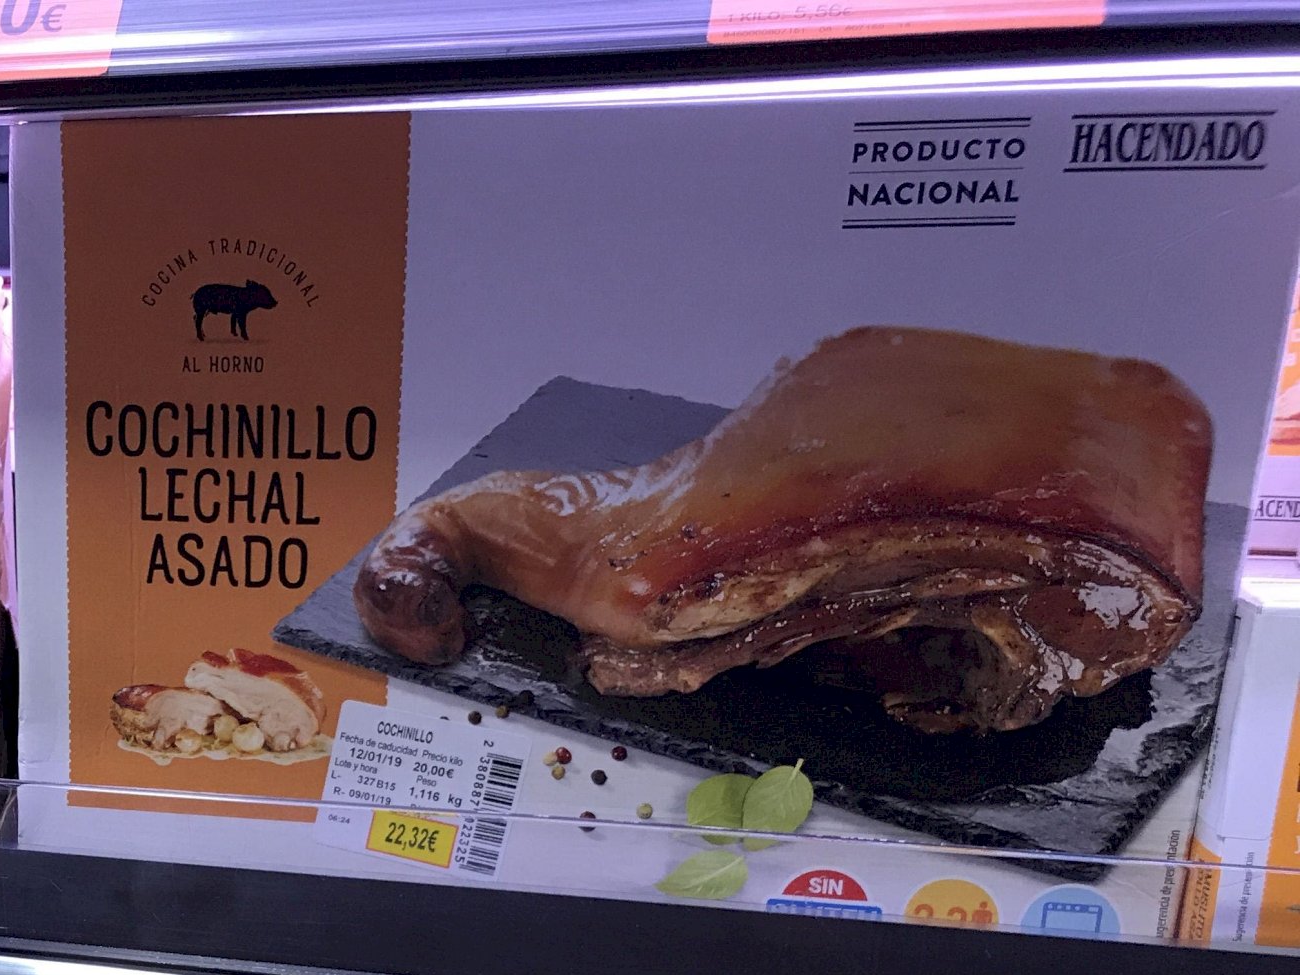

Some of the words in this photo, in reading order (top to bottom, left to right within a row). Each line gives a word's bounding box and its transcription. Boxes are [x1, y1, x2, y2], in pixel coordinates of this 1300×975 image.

[852, 137, 1026, 164] PRODUCTO
[1068, 119, 1268, 164] HACENDADO
[847, 179, 1019, 206] NACIONAL
[140, 248, 198, 308] COCINA
[208, 237, 320, 309] TRADICIONAL
[182, 356, 200, 373] AL
[209, 356, 264, 373] HORNO
[86, 400, 377, 461] COCHINILLO
[138, 466, 320, 526] LECHAL
[147, 533, 308, 589] ASADO
[377, 720, 434, 744] COCHINILLO
[483, 739, 494, 748] 2
[339, 731, 365, 746] Fecha
[365, 737, 377, 748] de
[377, 740, 419, 757] caducidad
[421, 749, 448, 763] Precio
[449, 755, 464, 767] kilo
[348, 747, 403, 767] 12/01/19
[412, 761, 454, 779] 20,00€
[334, 757, 352, 769] Lote
[359, 763, 378, 774] hora
[416, 774, 437, 787] Peso
[469, 755, 490, 807] 380887
[408, 786, 440, 801] 1,116
[447, 793, 463, 808] kg
[384, 821, 440, 853] 22,32€
[808, 876, 844, 896] SIN
[1156, 896, 1170, 938] ugerencia
